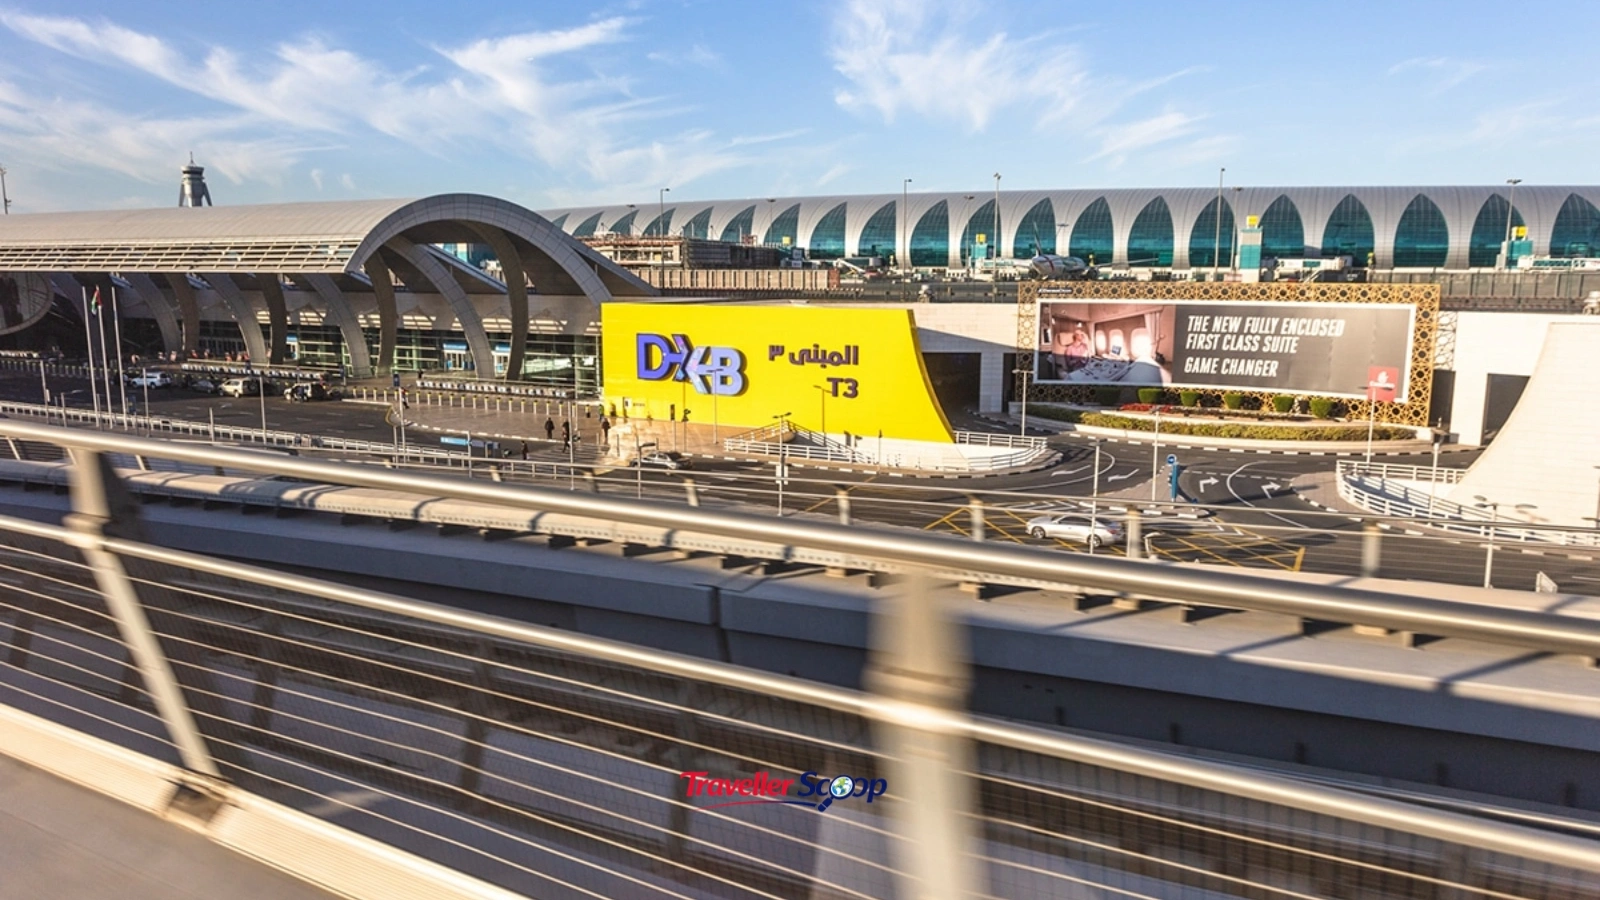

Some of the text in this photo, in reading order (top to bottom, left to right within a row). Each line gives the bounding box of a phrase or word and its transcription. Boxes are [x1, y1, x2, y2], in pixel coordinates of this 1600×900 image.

[1187, 315, 1346, 337] THE NEW FULLY ENCLOSED
[1185, 333, 1300, 354] FIRST CLASS SUITE
[636, 333, 746, 396] DXB
[788, 343, 859, 368] المبنى
[1184, 357, 1279, 378] GAME CHANGER
[826, 377, 859, 399] T3
